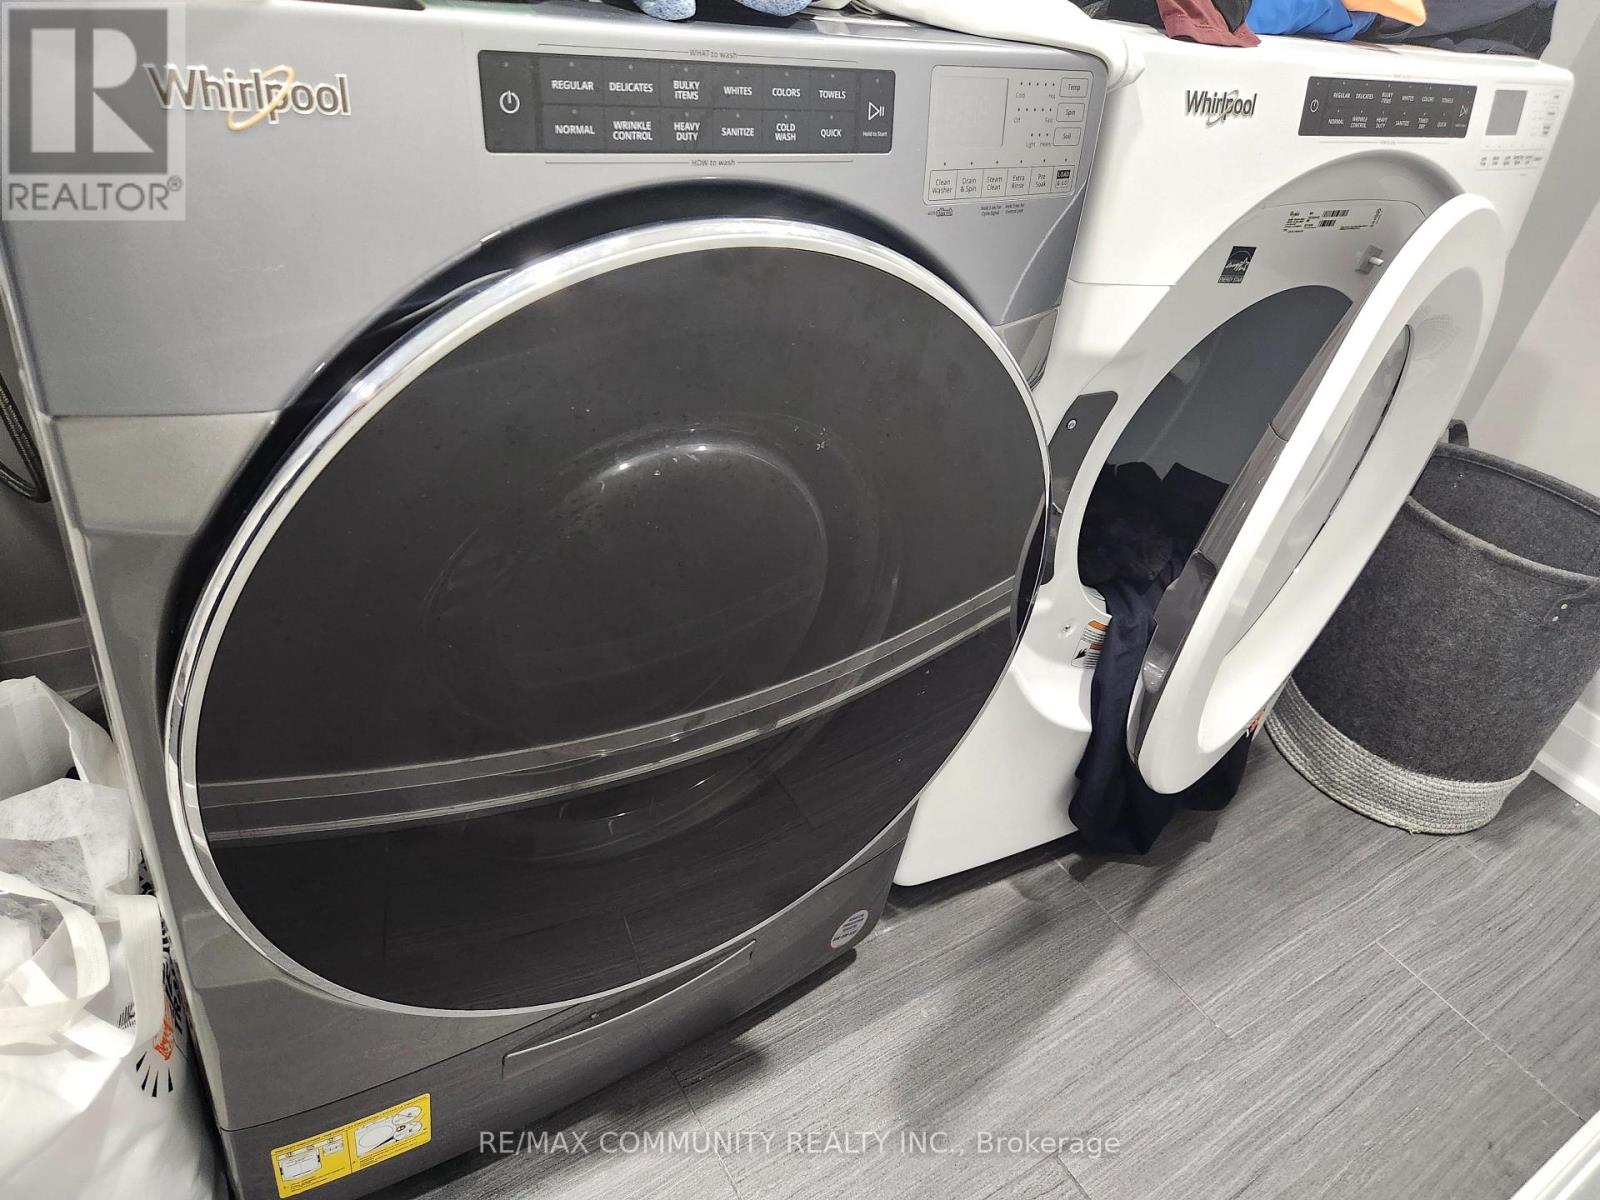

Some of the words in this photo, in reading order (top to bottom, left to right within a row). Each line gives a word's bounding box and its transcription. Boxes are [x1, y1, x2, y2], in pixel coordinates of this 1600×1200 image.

[689, 49, 710, 57] WHAT
[720, 51, 737, 59] wash
[551, 80, 594, 91] REGULAR
[609, 81, 653, 93] DELICATES
[673, 80, 700, 90] BULKY
[1068, 83, 1081, 93] Temp
[142, 63, 350, 126] Whirlpool
[674, 90, 699, 100] ITEMS
[723, 86, 753, 96] WHITES
[772, 87, 800, 97] COLORS
[818, 89, 846, 100] TOWELS
[1185, 89, 1258, 121] Whirlpool
[554, 125, 595, 135] NORMAL
[613, 121, 652, 131] WRINKLE
[673, 122, 701, 132] HEAVY
[776, 123, 796, 132] COLD
[612, 131, 653, 141] CONTROL
[676, 132, 699, 141] DUTY
[721, 127, 755, 137] SANITIZE
[775, 132, 797, 141] WASH
[820, 128, 842, 139] QUICK
[691, 159, 708, 167] HOW
[710, 159, 717, 167] to
[935, 178, 951, 186] Clean
[962, 177, 977, 185] Drain
[1012, 174, 1025, 182] Extra
[986, 183, 1001, 191] Clean
[1035, 180, 1046, 188] Soak
[932, 186, 952, 194] Washer
[966, 185, 977, 194] Spin
